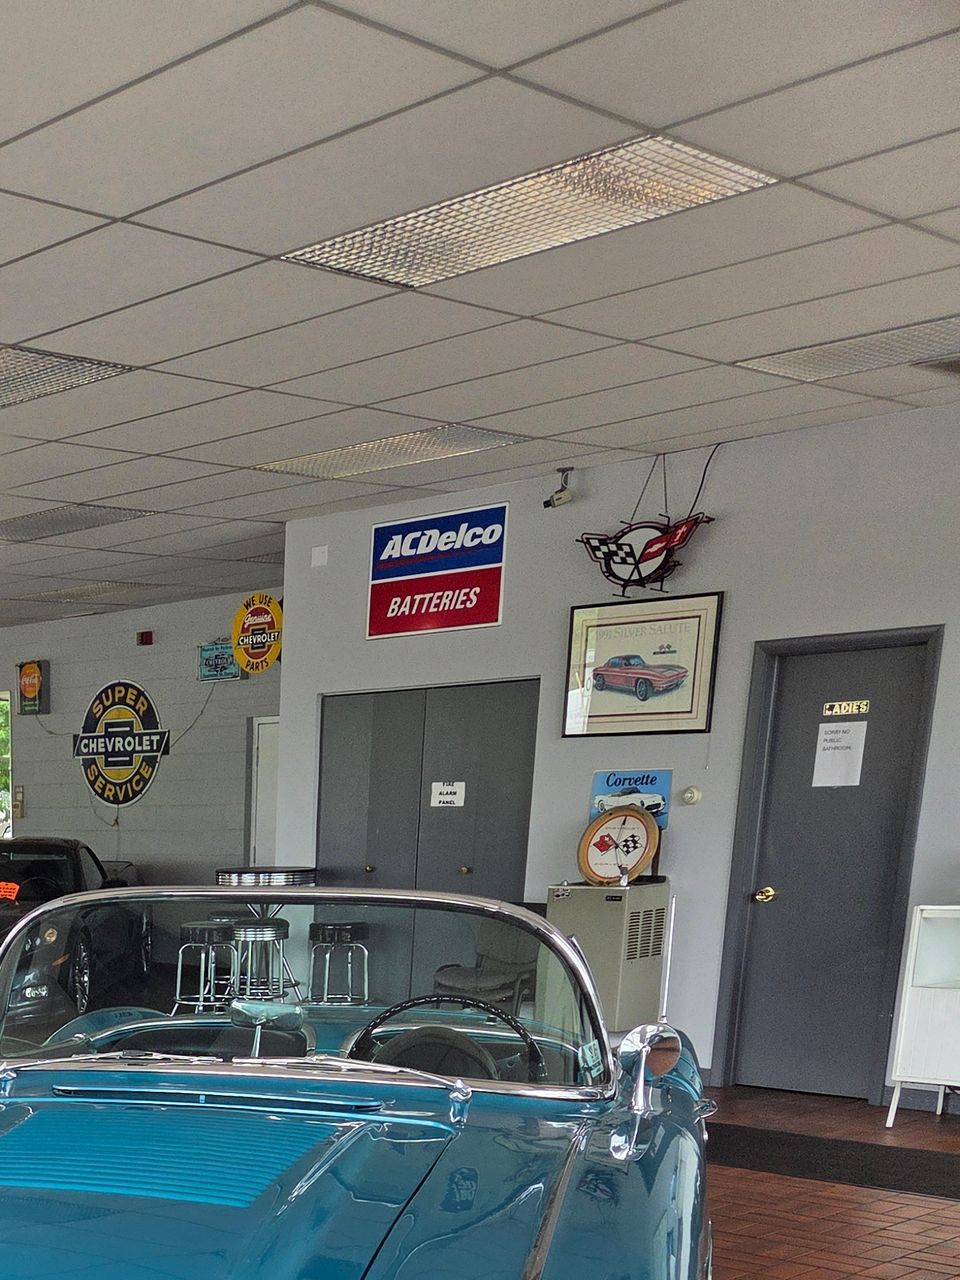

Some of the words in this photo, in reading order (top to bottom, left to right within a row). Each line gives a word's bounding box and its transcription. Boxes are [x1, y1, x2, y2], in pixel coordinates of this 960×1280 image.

[380, 523, 503, 561] ACDelco
[243, 596, 256, 612] WE
[258, 593, 273, 608] USE
[387, 587, 481, 618] BATTERIES
[244, 613, 273, 628] Genuine
[239, 632, 279, 645] CHEVROLET
[614, 625, 648, 640] SILVER
[648, 622, 690, 636] SALUTE
[245, 658, 269, 671] PARTS
[92, 686, 148, 718] SUPER
[81, 735, 160, 753] CHEVROLET
[88, 761, 153, 801] SERVICE
[606, 772, 658, 787] Corvette
